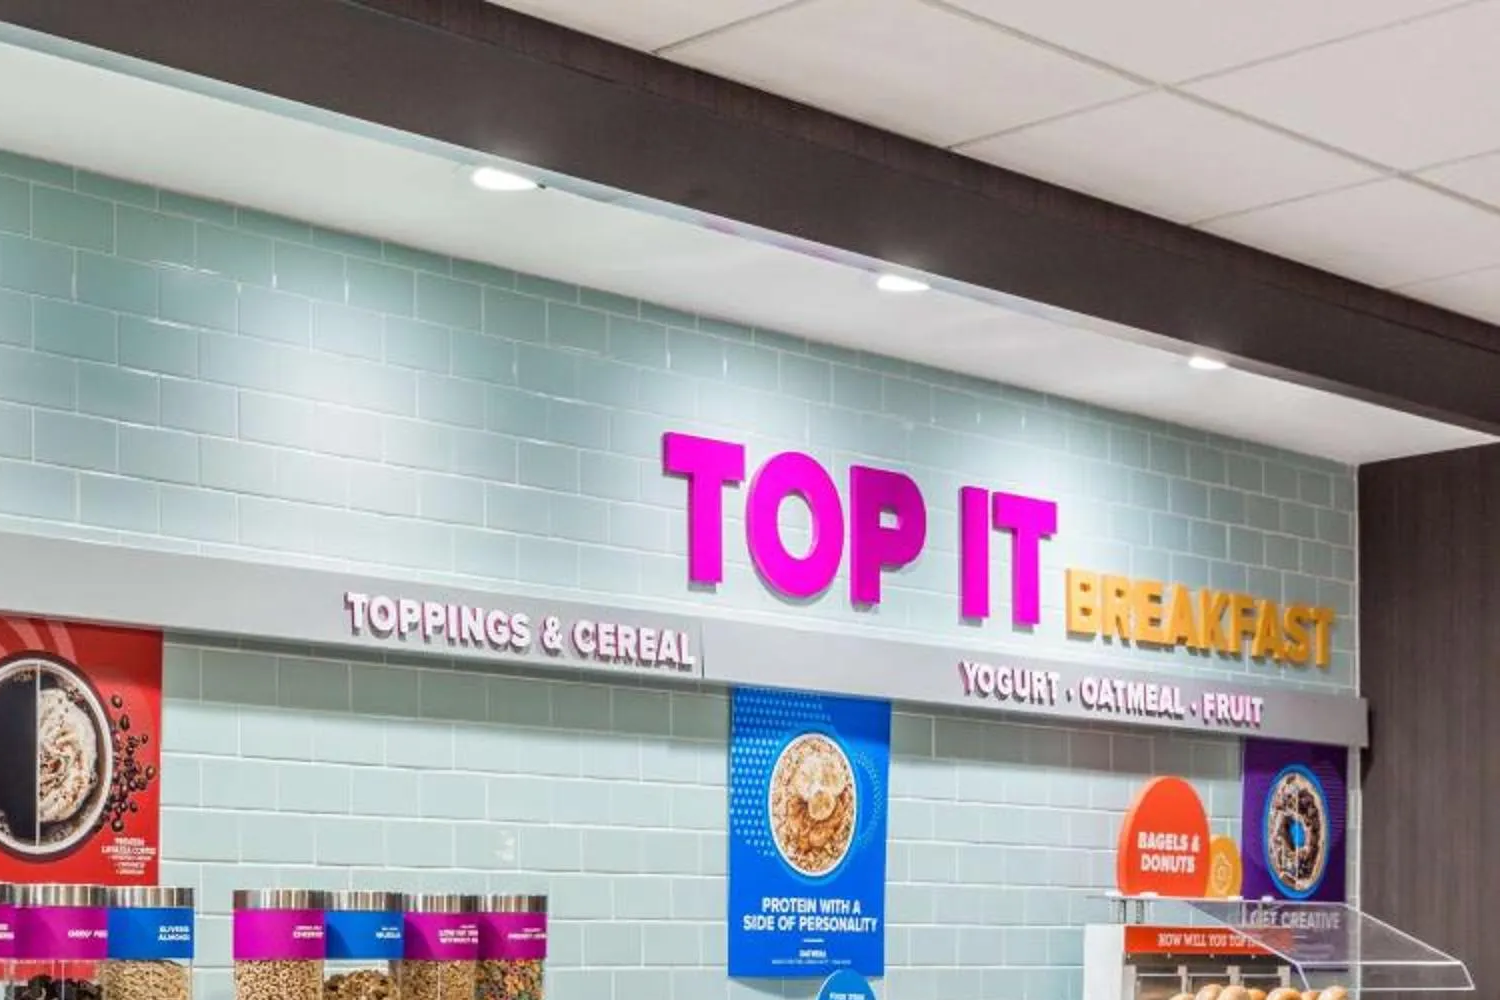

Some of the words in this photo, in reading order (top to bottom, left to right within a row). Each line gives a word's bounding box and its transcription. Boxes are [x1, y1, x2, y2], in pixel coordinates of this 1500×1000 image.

[662, 431, 927, 605] TOP
[960, 486, 1058, 625] IT
[1065, 568, 1337, 667] BREAKFAST
[344, 592, 531, 648] TOPPINGS
[542, 616, 563, 650] &
[572, 620, 696, 667] CEREAL
[959, 659, 1061, 702] YOGURT
[1081, 677, 1185, 716] OATMEAL
[1202, 693, 1264, 725] FRUIT
[1138, 831, 1188, 851] BAGELS
[1141, 853, 1195, 874] DONUTS
[762, 897, 817, 913] PROTEIN
[819, 899, 849, 914] WITH
[852, 899, 861, 914] A
[743, 915, 774, 931] SIDE
[777, 916, 796, 931] OF
[800, 916, 878, 932] PERSONALITY
[1282, 911, 1341, 930] CREATIVE
[1183, 932, 1206, 947] WILL
[1208, 933, 1228, 948] YOU
